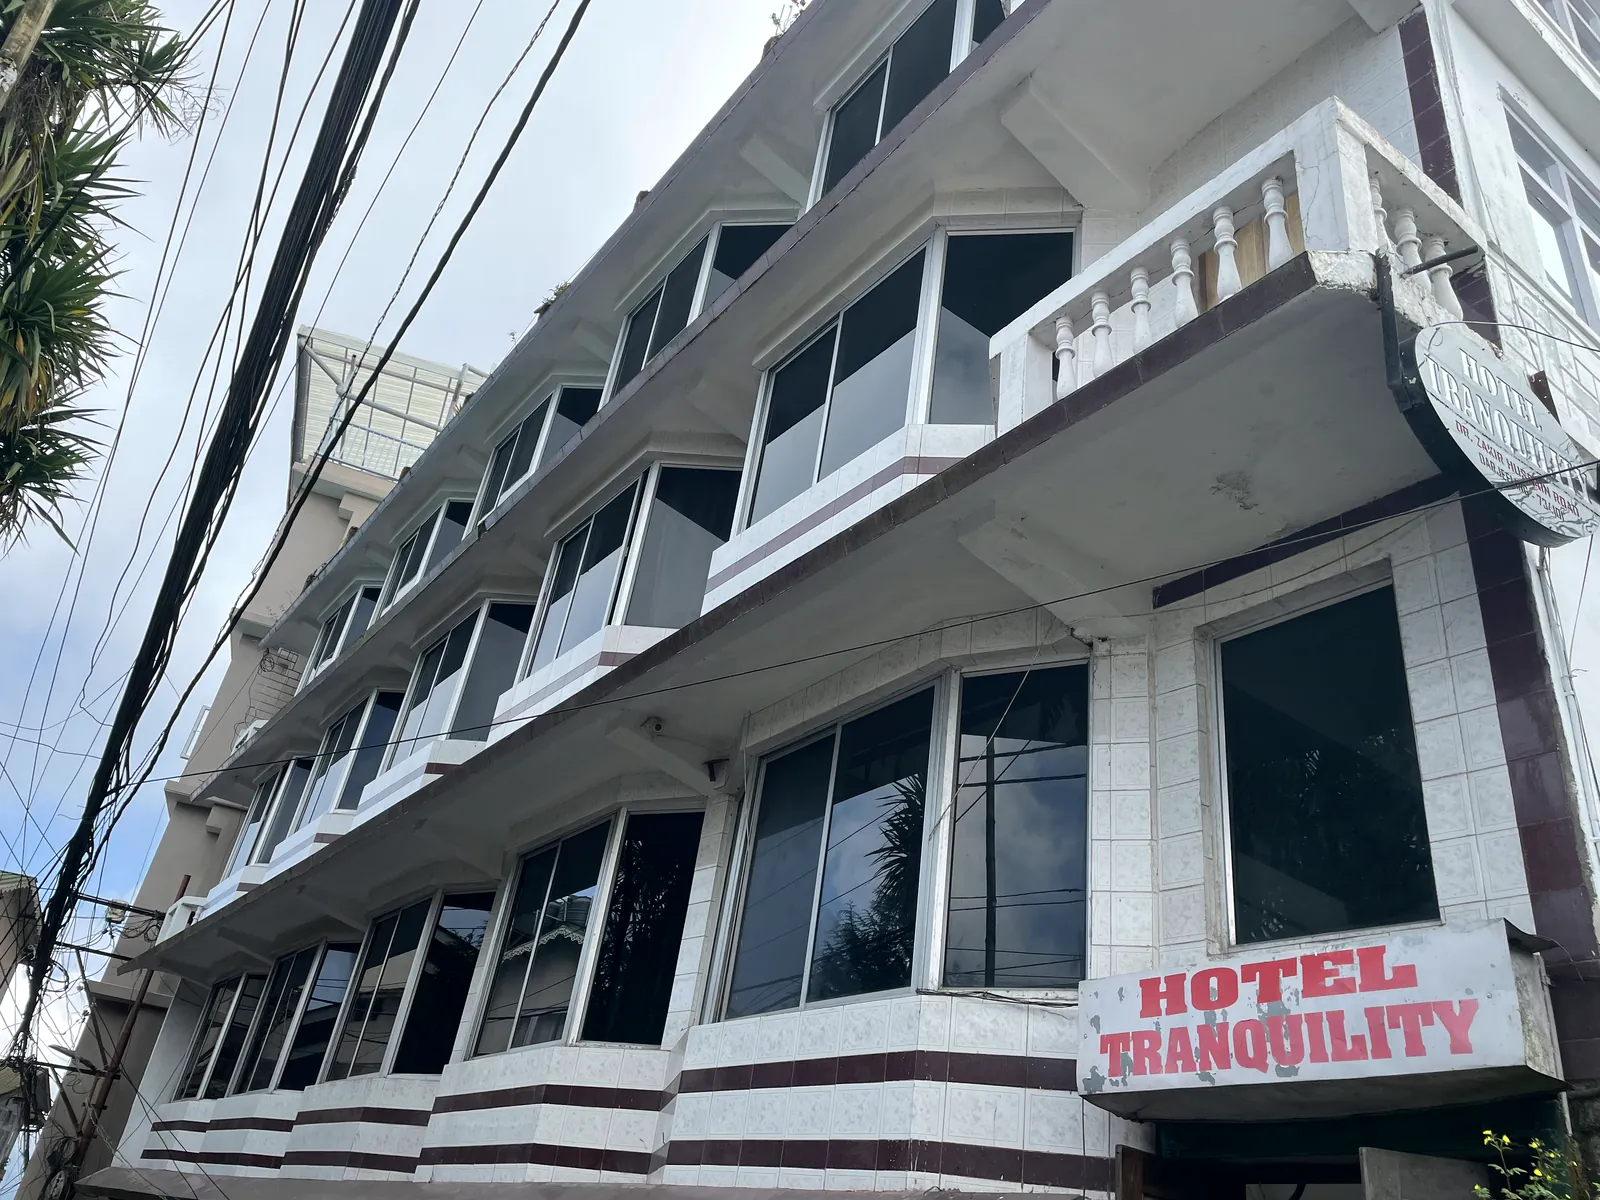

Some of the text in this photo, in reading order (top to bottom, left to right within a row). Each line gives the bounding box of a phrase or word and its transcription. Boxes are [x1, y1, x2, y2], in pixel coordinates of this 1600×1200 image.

[1459, 347, 1543, 431] HOTEL
[1455, 420, 1474, 442] DR.
[1474, 434, 1504, 464] ZAKIR
[1139, 945, 1418, 1018] HOTEL
[1099, 999, 1479, 1077] TRANQUILITY
